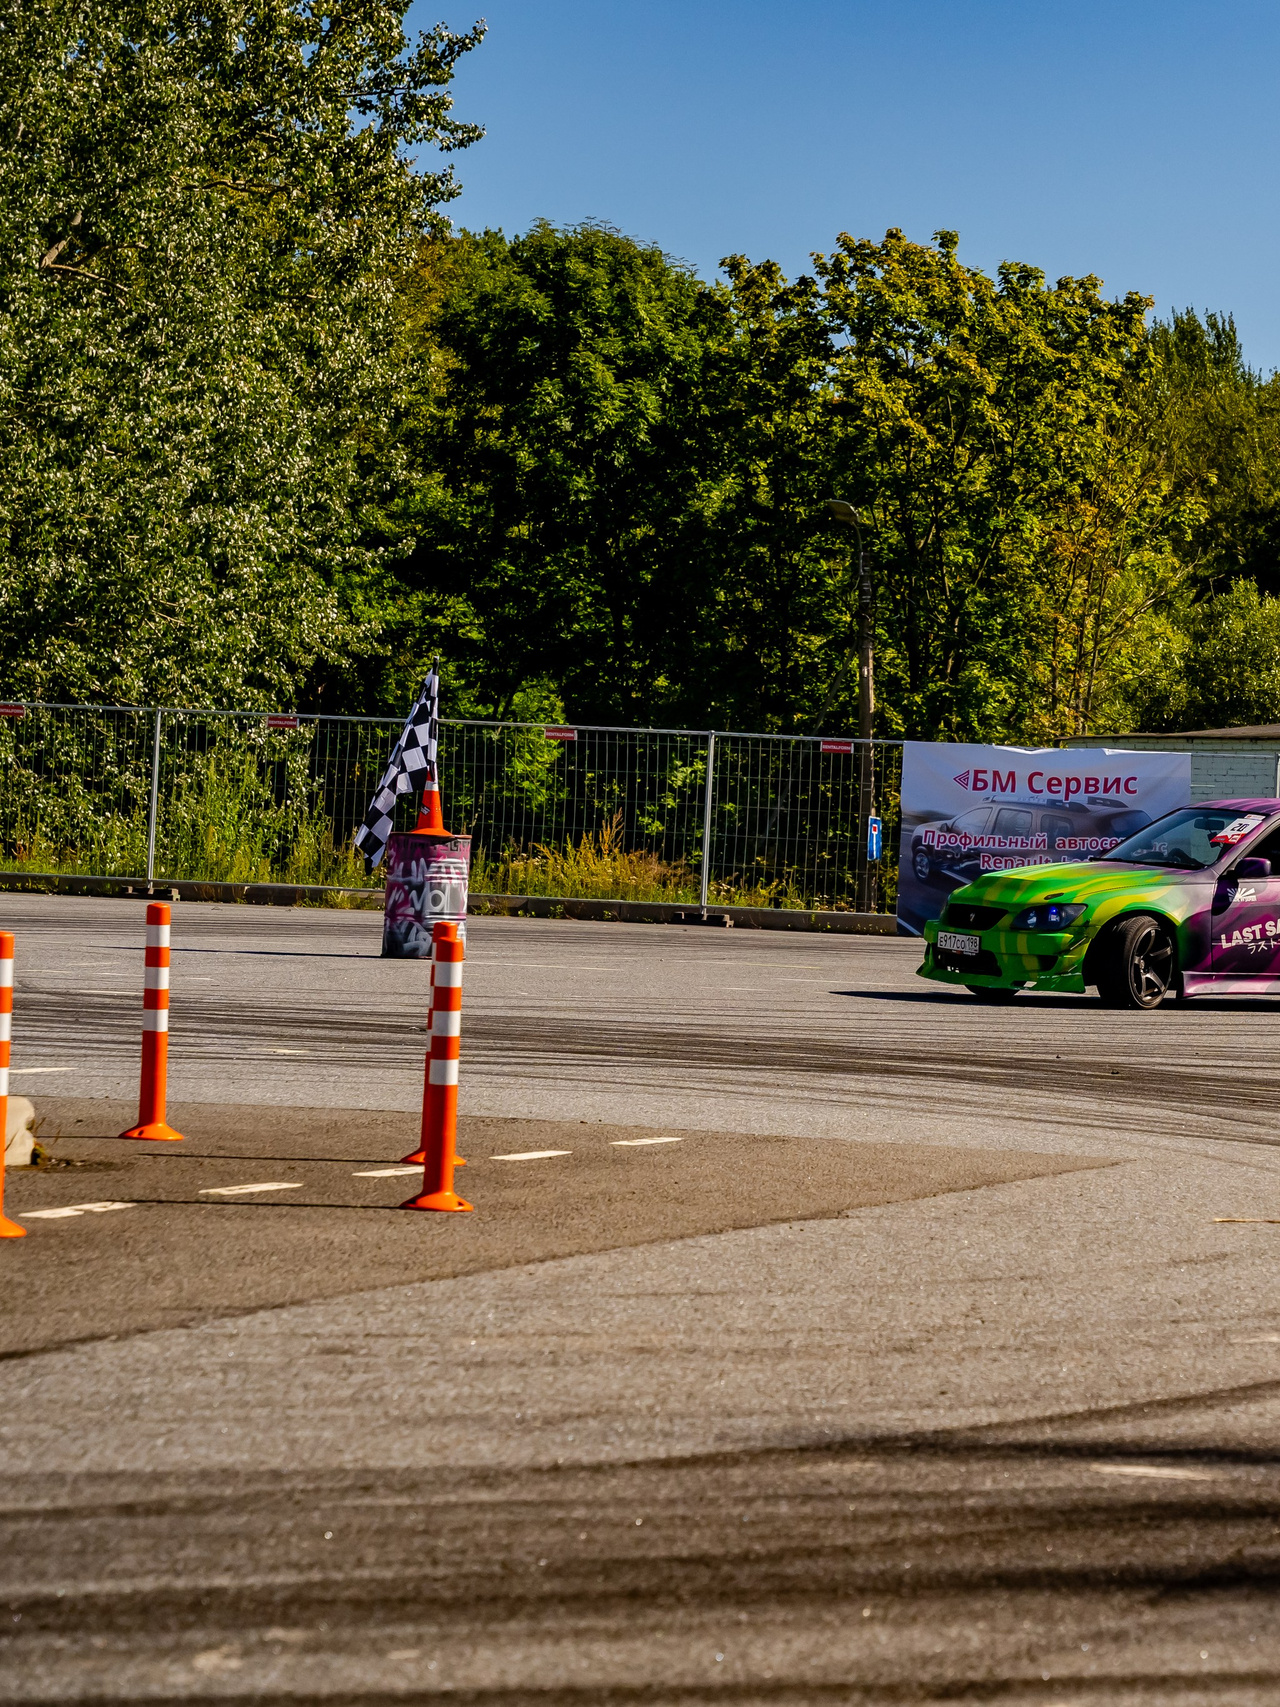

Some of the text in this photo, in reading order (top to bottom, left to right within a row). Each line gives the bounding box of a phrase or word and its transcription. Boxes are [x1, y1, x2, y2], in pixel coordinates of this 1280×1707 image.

[971, 769, 1139, 802] БМ Сервис
[922, 829, 1049, 852] Профильный
[1220, 924, 1263, 949] LAST
